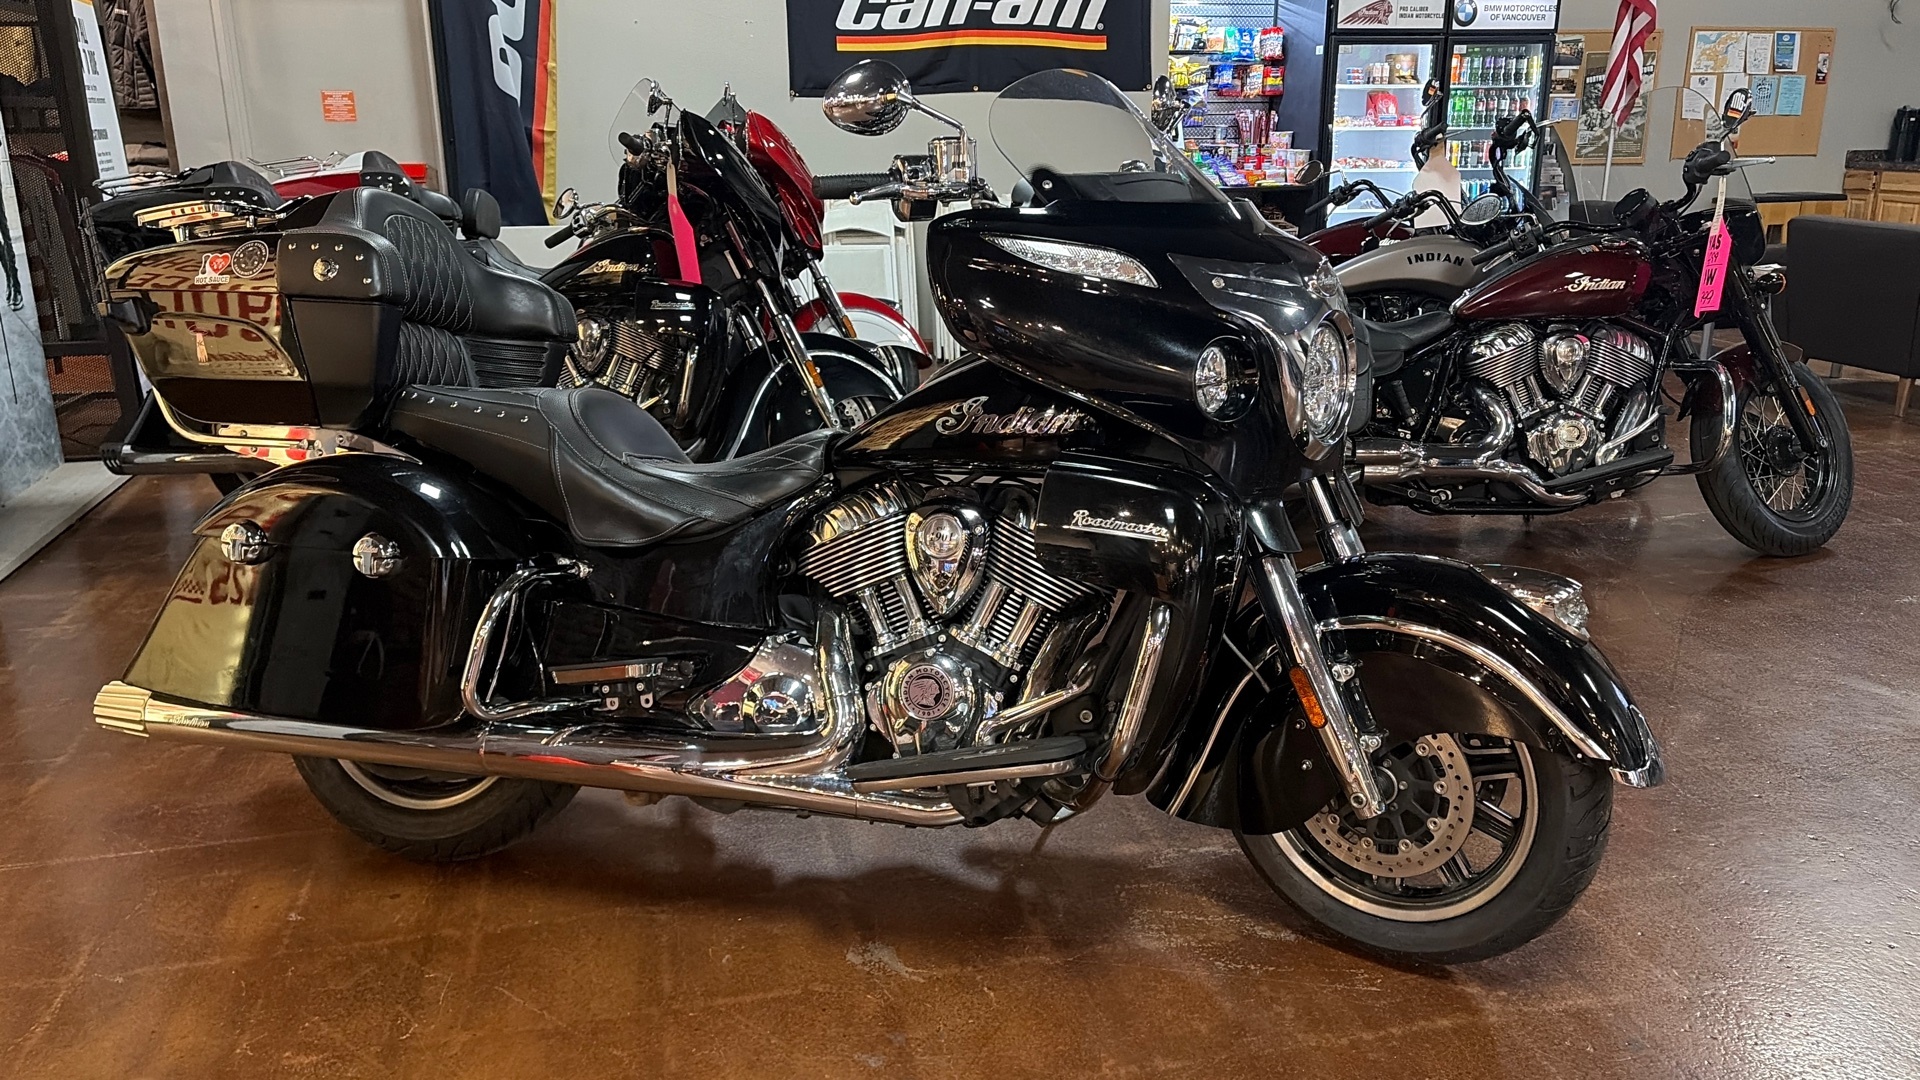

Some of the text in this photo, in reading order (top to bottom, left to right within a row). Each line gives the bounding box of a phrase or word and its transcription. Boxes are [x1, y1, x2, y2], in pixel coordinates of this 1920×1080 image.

[1407, 252, 1464, 266] INDIAN
[196, 276, 207, 284] HOT
[208, 276, 229, 284] SAUCE
[1568, 276, 1626, 292] Indian
[935, 396, 1077, 435] Indian
[1071, 509, 1170, 537] Roadmaster
[916, 667, 950, 708] MOTORCYCLE
